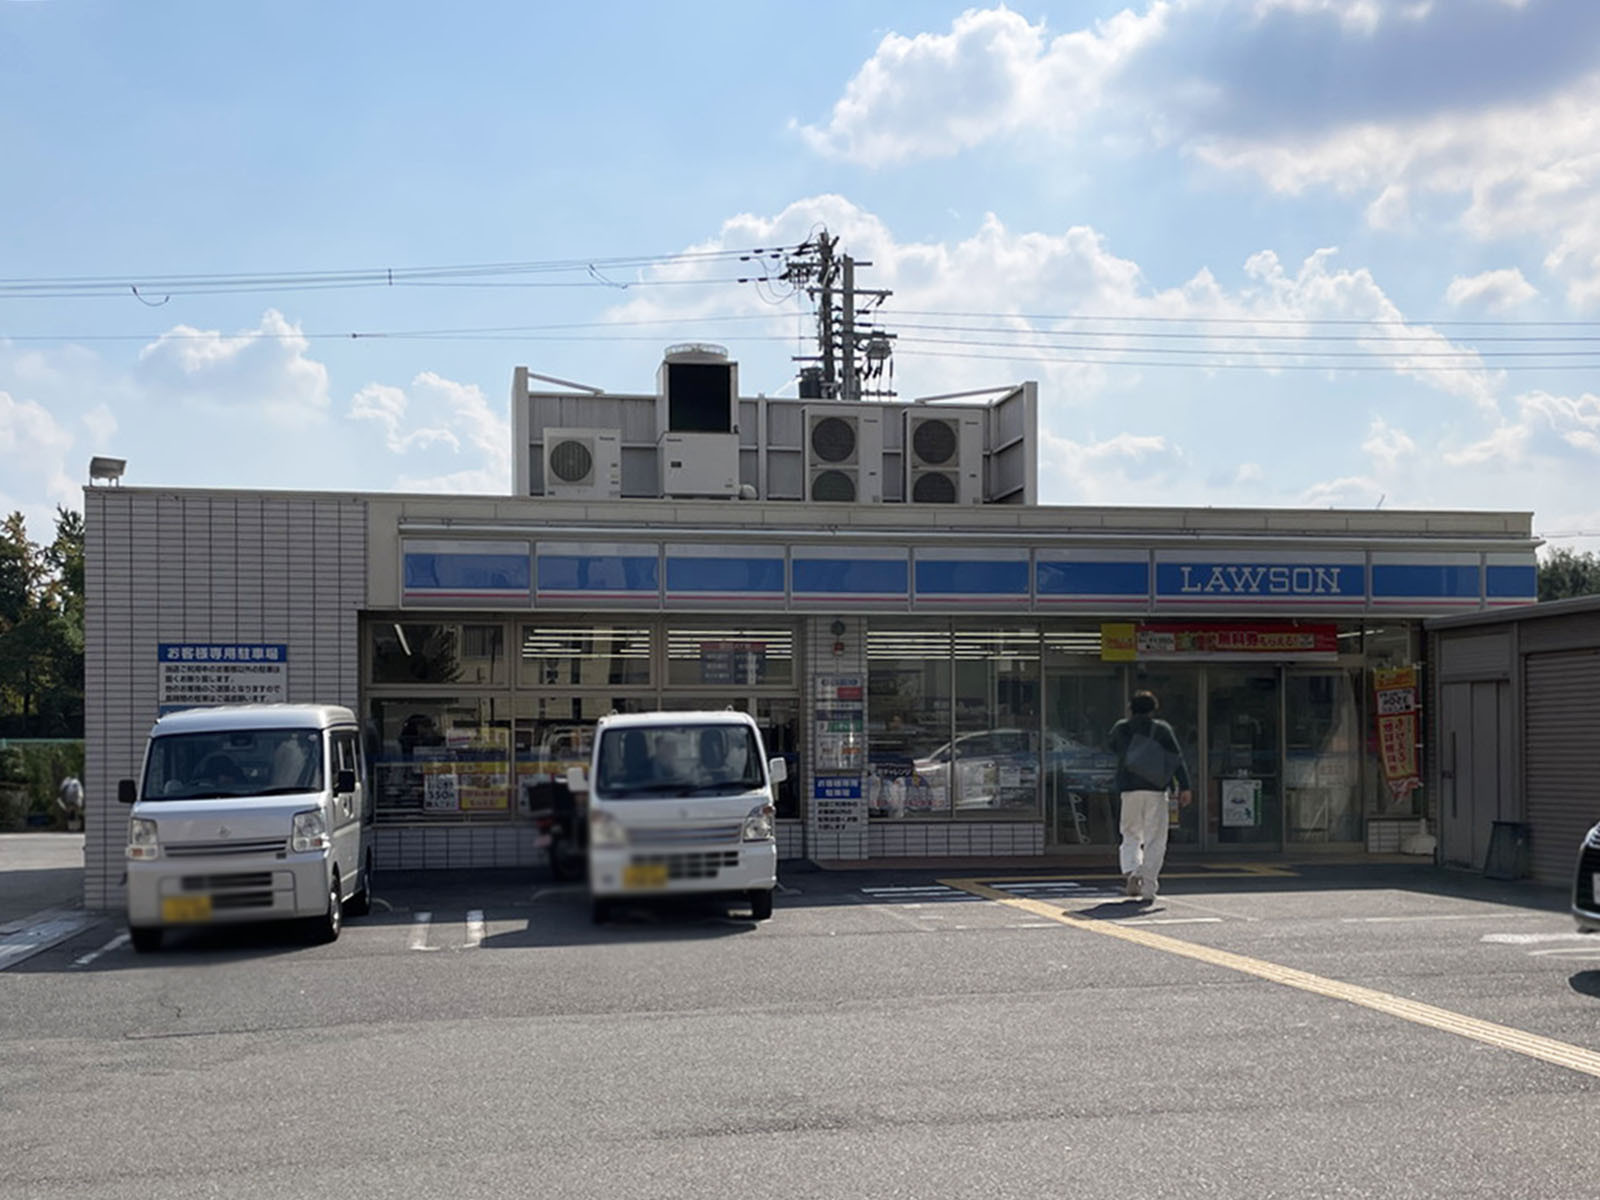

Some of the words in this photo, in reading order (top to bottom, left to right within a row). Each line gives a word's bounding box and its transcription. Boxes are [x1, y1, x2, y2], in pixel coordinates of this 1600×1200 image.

[1180, 566, 1341, 593] LAWSON
[166, 647, 279, 660] お客様専用駐車場
